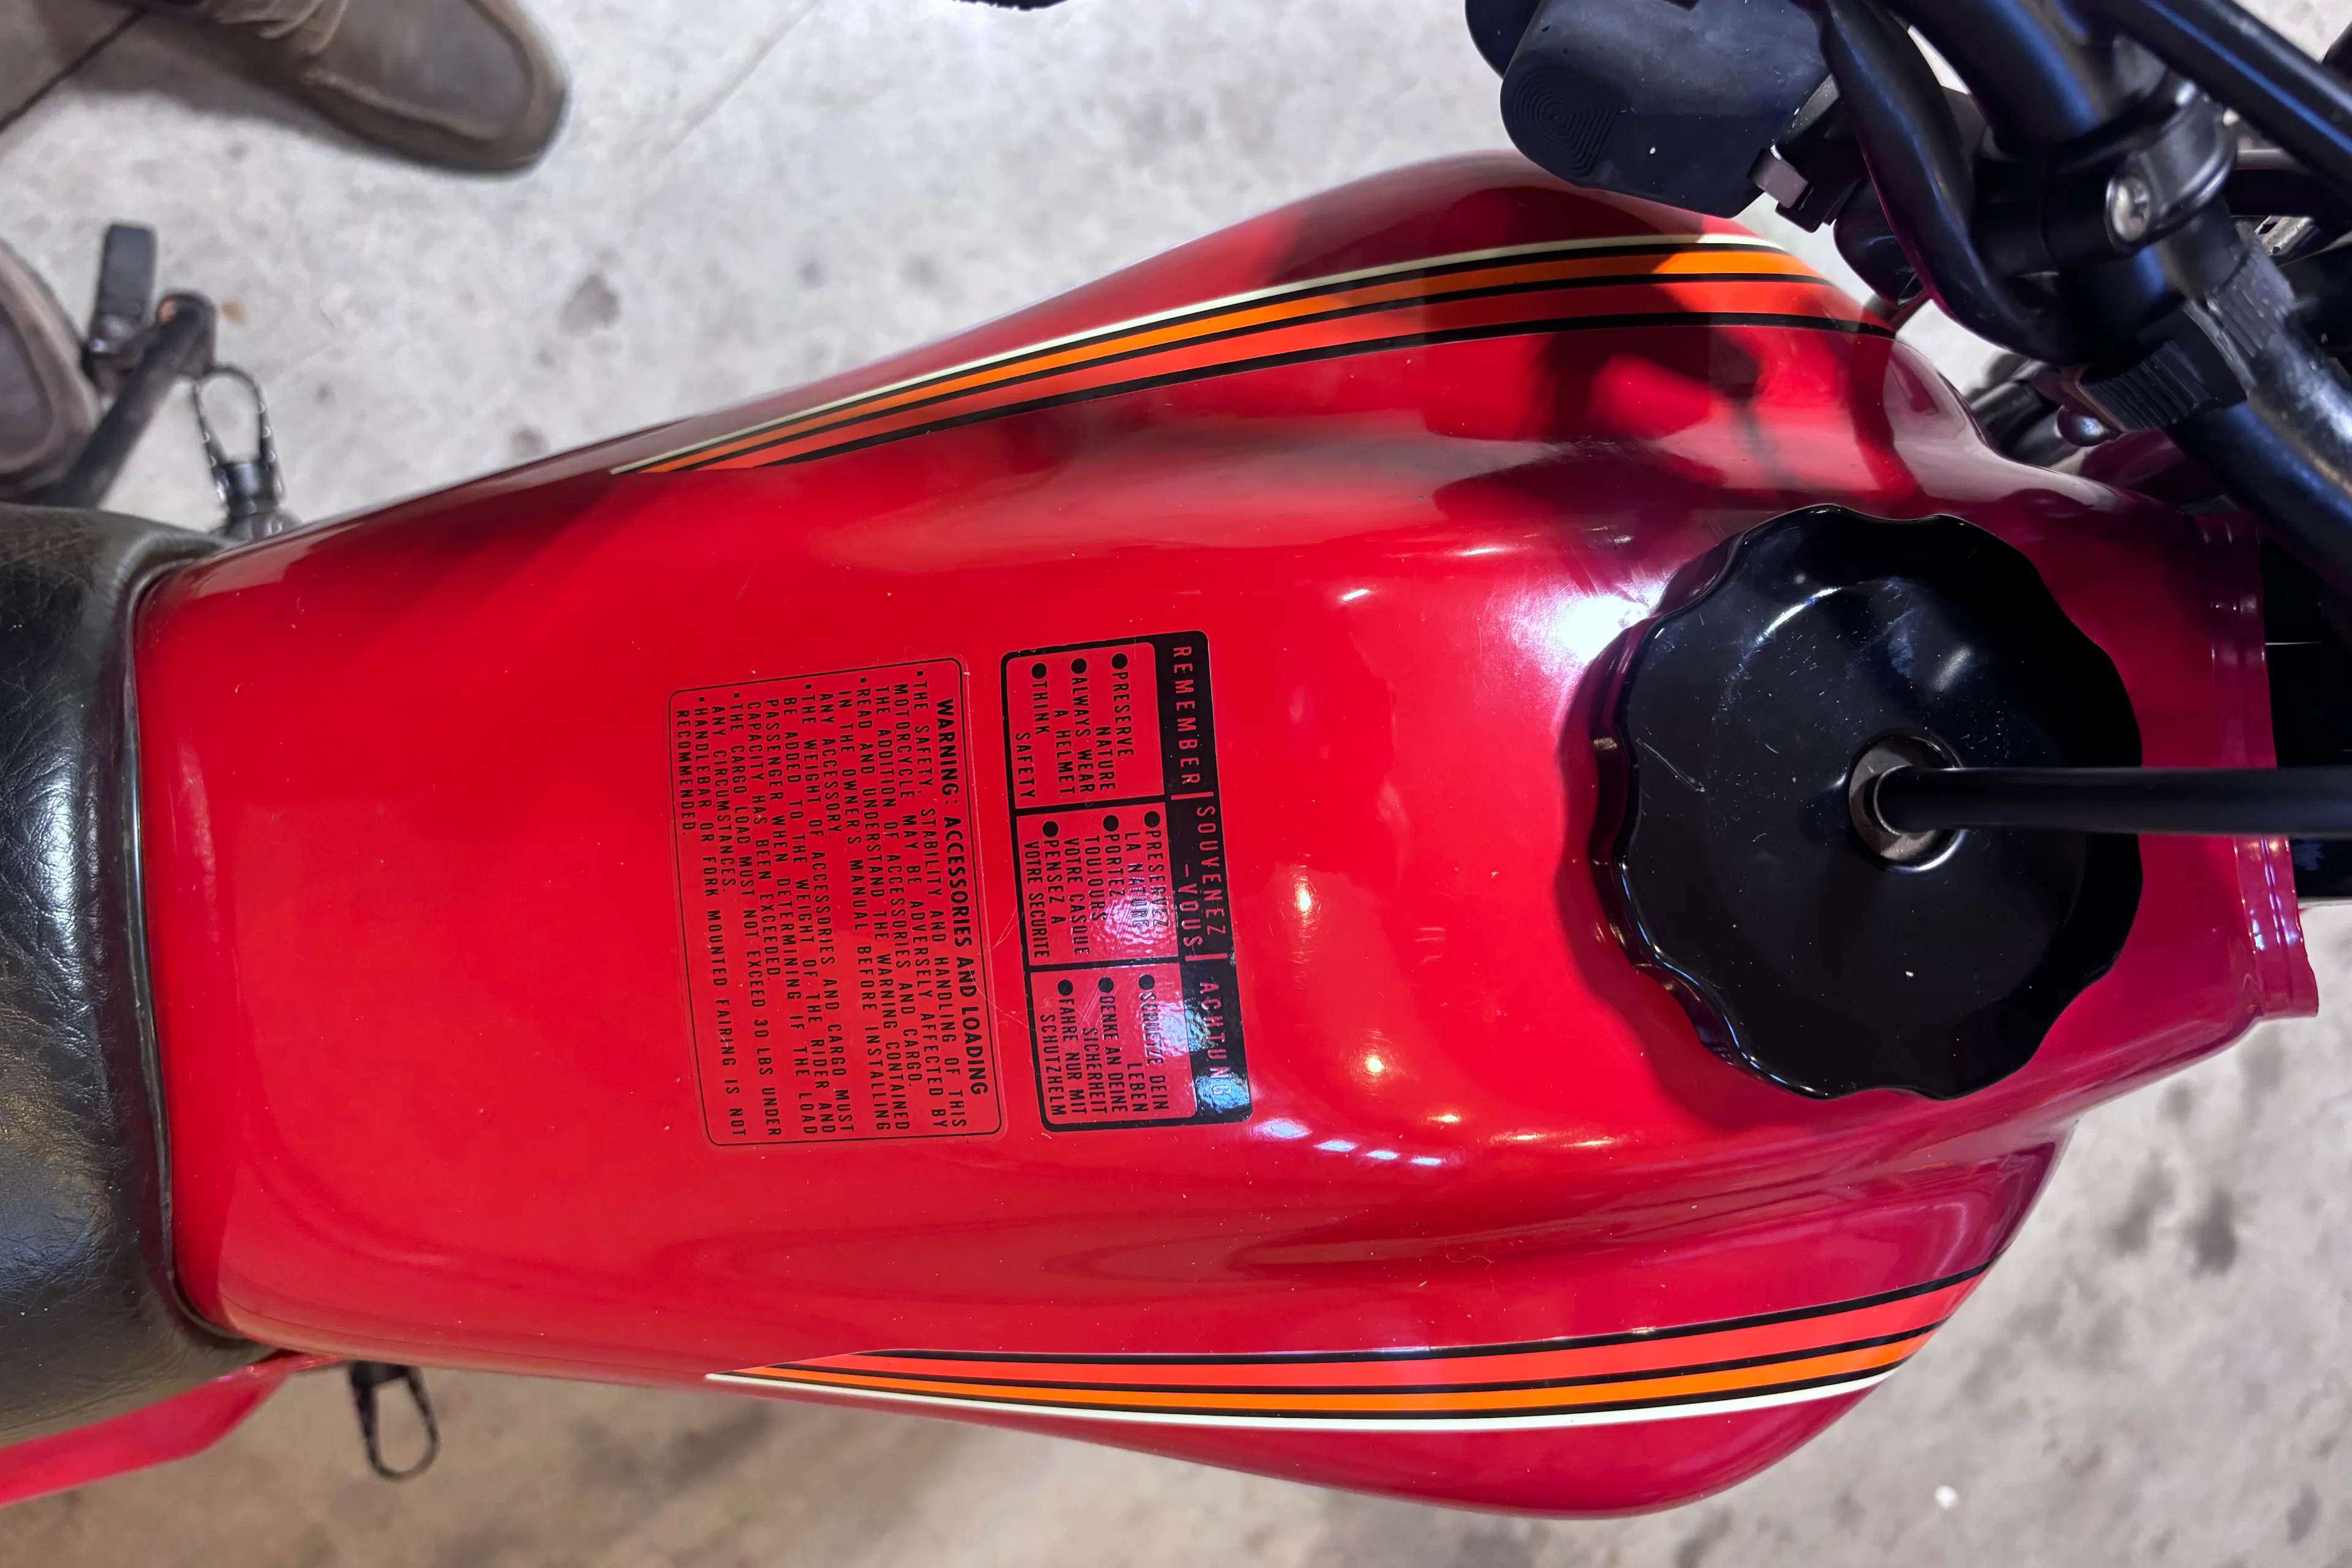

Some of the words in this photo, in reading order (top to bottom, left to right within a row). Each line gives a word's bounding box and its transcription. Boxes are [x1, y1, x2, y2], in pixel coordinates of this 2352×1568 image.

[729, 703, 744, 731] THE
[783, 696, 797, 716] BE
[801, 694, 816, 725] THE
[820, 693, 834, 723] ANY
[838, 690, 853, 708] IN
[856, 688, 873, 729] READ
[875, 685, 891, 714] THE
[913, 680, 929, 710] THE
[1031, 680, 1050, 734] THINK
[1072, 677, 1091, 737] ALWAYS
[1112, 671, 1134, 757] PRESERVE
[1173, 646, 1200, 784] REMEMBER
[712, 706, 726, 736] ANY
[747, 701, 764, 780] CAPACITY
[839, 722, 855, 753] THE
[894, 684, 918, 798] MOTORCYCLE
[676, 710, 696, 836] RECOMMENDED.
[694, 707, 712, 808] HANDLEBAR
[731, 745, 747, 793] CARGO
[765, 699, 784, 800] PASSENGER
[784, 731, 801, 783] ADDED
[803, 739, 821, 802] WEIGHT
[859, 743, 875, 774] AND
[877, 729, 897, 807] ADDITION
[914, 725, 933, 794] SAFETY,
[936, 698, 959, 805] WARNING:
[1015, 732, 1036, 797] SAFETY
[1055, 729, 1076, 794] HELMET
[1077, 748, 1095, 793] WEAR
[1095, 726, 1116, 791] NATURE
[752, 795, 768, 825] HAS
[788, 799, 804, 819] TO
[821, 739, 842, 839] ACCESSORY.
[842, 769, 862, 845] OWNER'S
[699, 822, 714, 842] OR
[713, 750, 736, 892] CIRCUMSTANCES.
[734, 806, 751, 844] LOAD
[772, 815, 789, 862] WHEN
[808, 819, 824, 836] OF
[862, 788, 885, 897] UNDERSTAND
[883, 821, 899, 839] OF
[902, 815, 919, 849] MAY
[1125, 832, 1142, 851] LA
[755, 839, 772, 880] BEEN
[791, 834, 807, 864] THE
[920, 808, 942, 895] STABILITY
[1024, 840, 1043, 884] VOTRE
[1043, 839, 1065, 904] PENSEZ
[1063, 837, 1083, 884] VOTRE
[1104, 833, 1125, 897] PORTEZ
[1196, 805, 1226, 935] SOUVENEZ
[703, 856, 718, 897] FORK
[739, 856, 755, 895] MUST
[849, 859, 869, 930] MANUAL
[906, 865, 922, 884] BE
[943, 816, 972, 947] ACCESSORIES
[1084, 835, 1107, 921] TOUJOURS
[1128, 863, 1150, 929] NATURE
[1145, 829, 1169, 927] PRESERVEZ
[743, 910, 759, 937] NOT
[795, 878, 815, 942] WEIGHT
[811, 851, 835, 964] ACCESSORIES
[872, 910, 889, 940] THE
[886, 854, 911, 968] ACCESSORIES
[929, 910, 946, 942] AND
[1028, 892, 1050, 958] SECURITE
[1050, 916, 1066, 924] A
[1069, 894, 1090, 954] CASQUE
[707, 910, 727, 986] MOUNTED
[760, 893, 780, 981] EXCEEDED.
[777, 878, 801, 1000] DETERMINING
[909, 901, 933, 997] ADVERSELY
[746, 951, 766, 1007] EXCEED
[802, 959, 818, 976] OF
[857, 946, 877, 1010] BEFORE
[876, 953, 898, 1029] WARNING
[956, 957, 977, 997] AND
[805, 993, 823, 1023] THE
[823, 979, 839, 1010] AND
[898, 982, 915, 1014] AND
[934, 957, 957, 1042] HANDLING
[1099, 995, 1118, 1040] DENKE
[715, 1000, 736, 1066] FAIRING
[754, 1019, 769, 1038] 30
[789, 1016, 805, 1029] IF
[1058, 998, 1078, 1042] FAHRE
[1199, 982, 1233, 1096] ACHTUNG
[756, 1047, 773, 1075] LBS
[793, 1046, 810, 1076] THE
[810, 1039, 829, 1088] RIDER
[827, 1024, 846, 1076] CARGO
[903, 1028, 922, 1087] CARGO.
[920, 1013, 943, 1096] AFFECTED
[944, 1057, 960, 1074] OF
[962, 1006, 988, 1095] LOADING
[1040, 1014, 1067, 1115] SCHUTZHELM
[1065, 1052, 1082, 1080] NUR
[1082, 1027, 1107, 1113] SICHERHEIT
[1105, 1047, 1121, 1065] AN
[725, 1079, 740, 1094] IS
[865, 1027, 891, 1130] INSTALLING
[885, 1042, 910, 1129] CONTAINED
[1069, 1089, 1087, 1114] MIT
[1107, 1072, 1128, 1112] DEINE
[1127, 1063, 1148, 1112] LEBEN
[1149, 1075, 1169, 1110] DEIN
[729, 1107, 746, 1134] NOT
[761, 1087, 782, 1136] UNDER
[799, 1093, 818, 1134] LOAD
[818, 1102, 835, 1133] AND
[834, 1090, 854, 1131] MUST
[931, 1109, 948, 1127] BY
[948, 1090, 967, 1127] THIS
